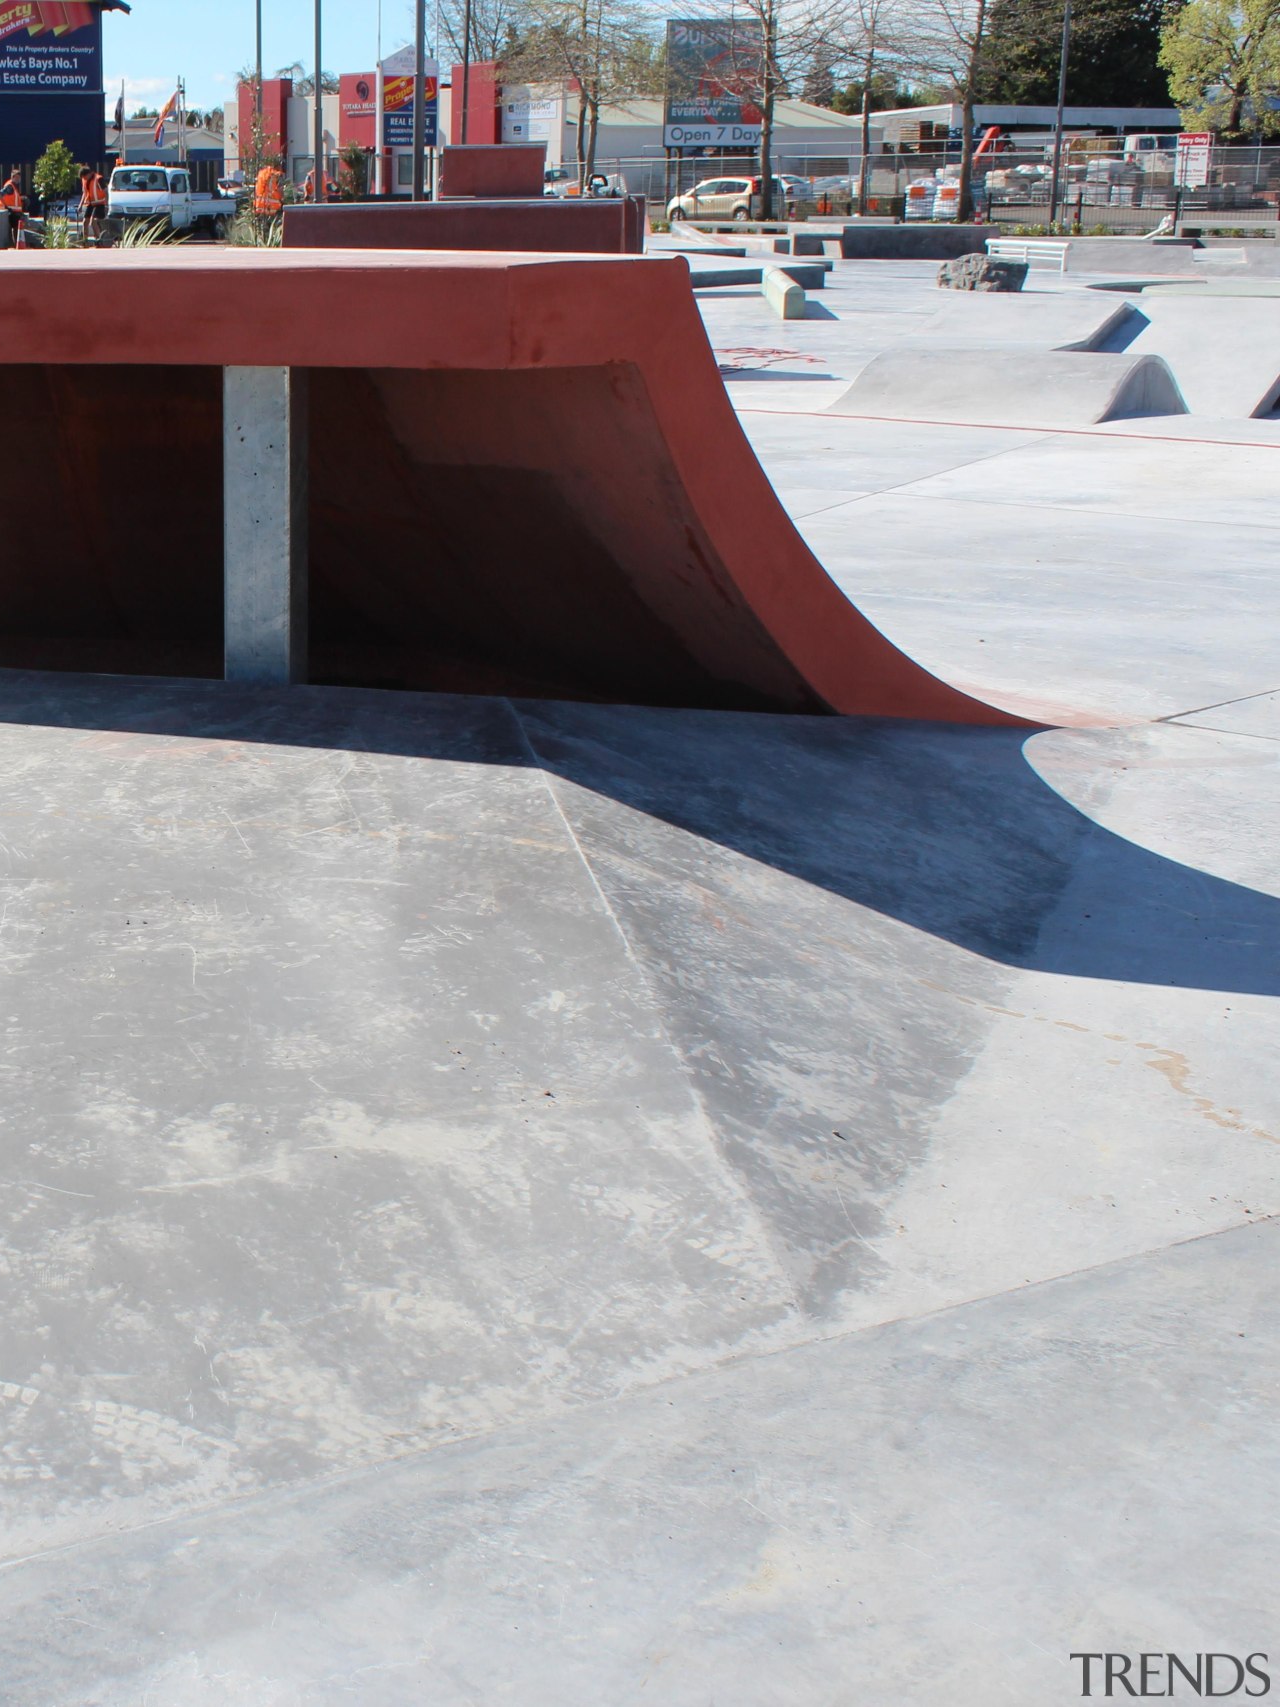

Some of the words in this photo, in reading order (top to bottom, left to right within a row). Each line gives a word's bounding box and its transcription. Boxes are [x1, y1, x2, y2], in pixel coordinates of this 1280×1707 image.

[24, 45, 47, 53] Property
[70, 46, 94, 54] Country!
[28, 57, 54, 71] Bays
[55, 58, 78, 69] No.1
[3, 73, 36, 84] Estate
[38, 73, 88, 87] Company
[390, 117, 407, 126] REAL
[670, 127, 710, 144] Open
[717, 127, 726, 140] 7
[732, 127, 761, 143] Day
